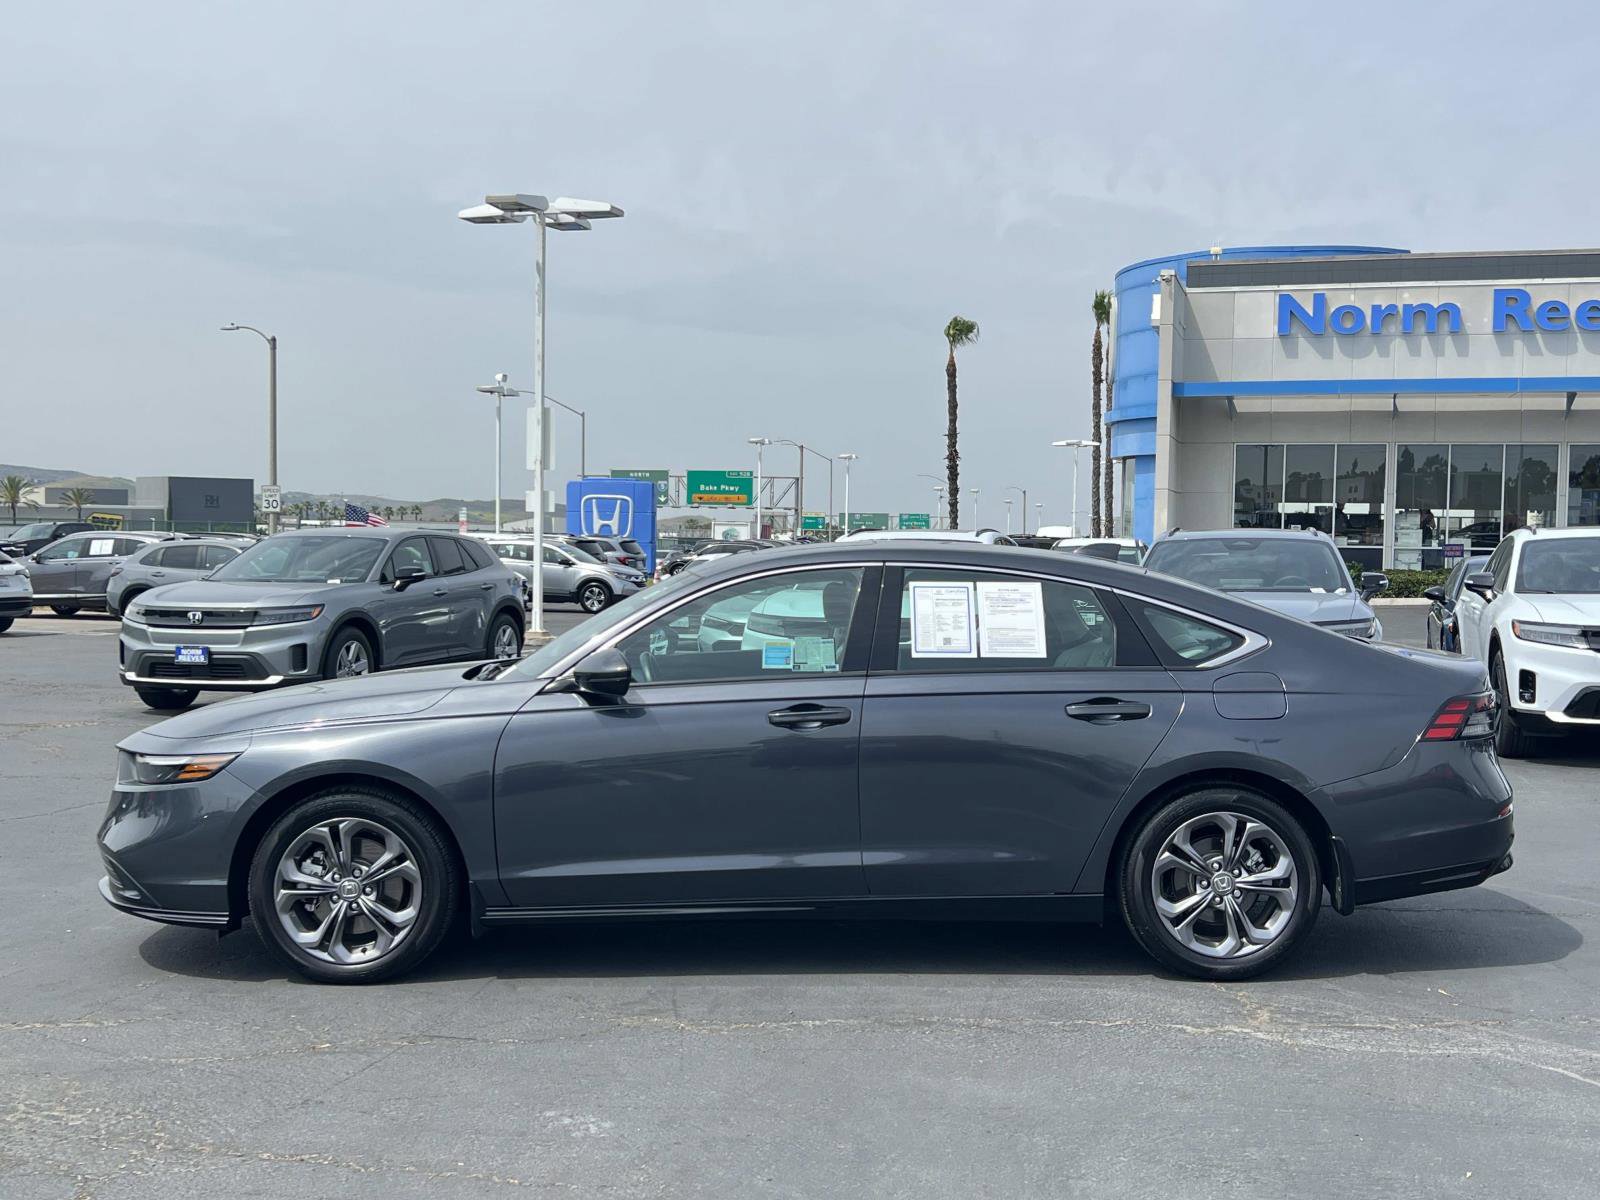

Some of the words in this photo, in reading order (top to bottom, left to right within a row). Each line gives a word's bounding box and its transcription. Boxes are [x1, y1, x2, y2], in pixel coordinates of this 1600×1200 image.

[1277, 292, 1461, 336] Norm
[720, 484, 739, 492] Pkwy
[264, 499, 279, 509] 30
